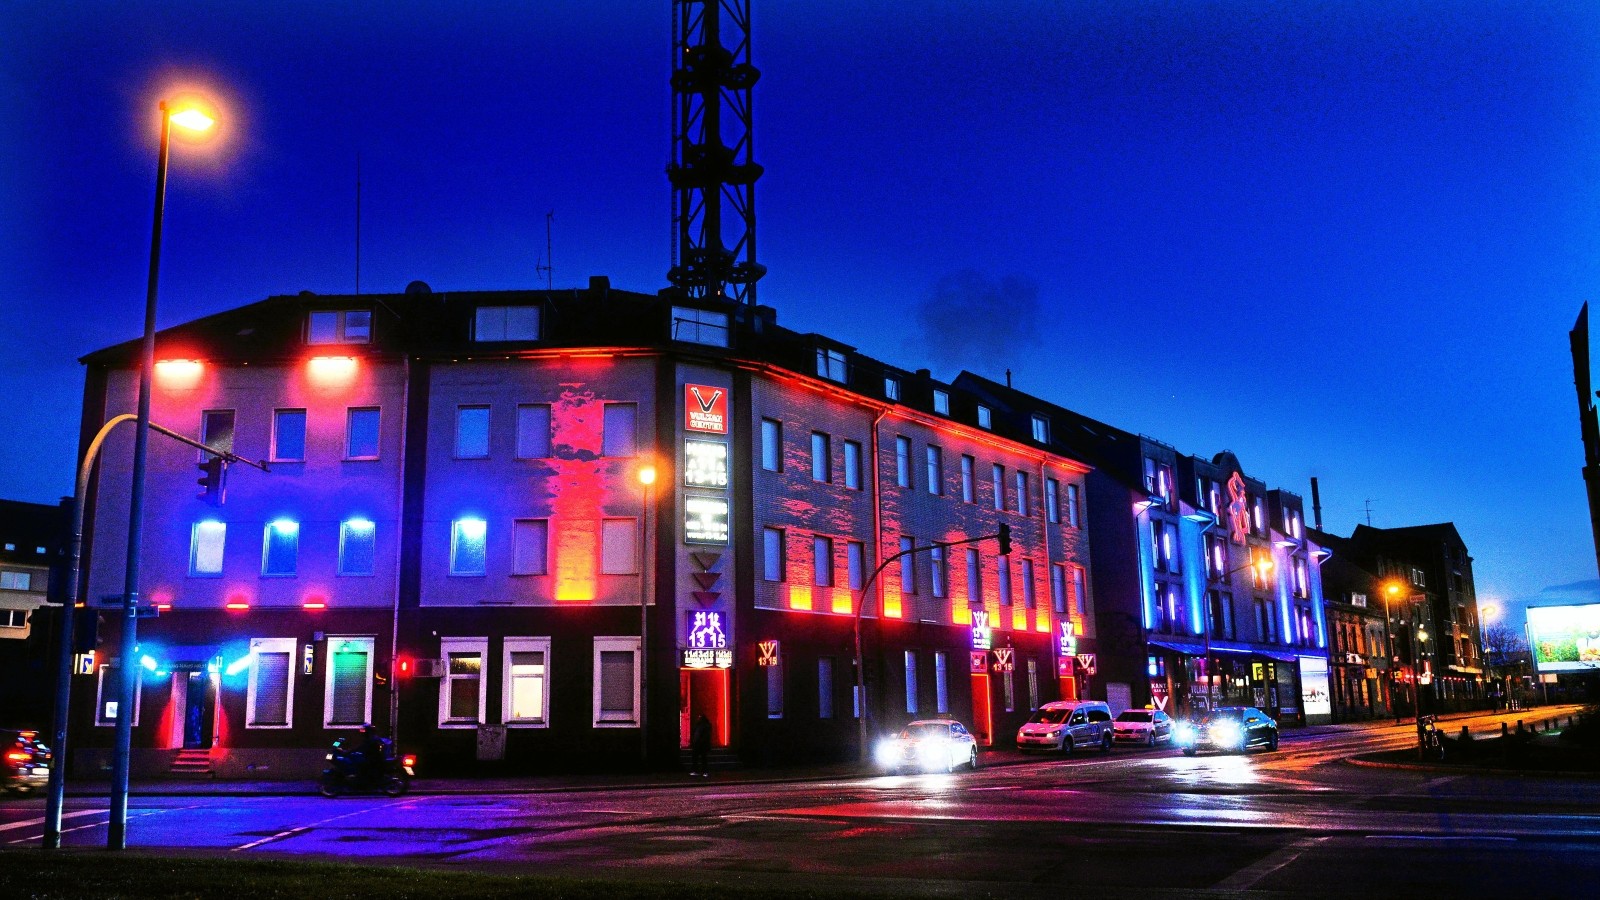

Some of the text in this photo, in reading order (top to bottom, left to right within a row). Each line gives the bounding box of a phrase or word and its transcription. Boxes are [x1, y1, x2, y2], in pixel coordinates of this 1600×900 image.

[690, 411, 722, 423] VULKAN
[690, 420, 723, 430] CENTER
[689, 631, 726, 648] 13 15
[758, 656, 777, 666] 13 15
[994, 662, 1013, 671] 13 15
[1087, 666, 1095, 675] 15
